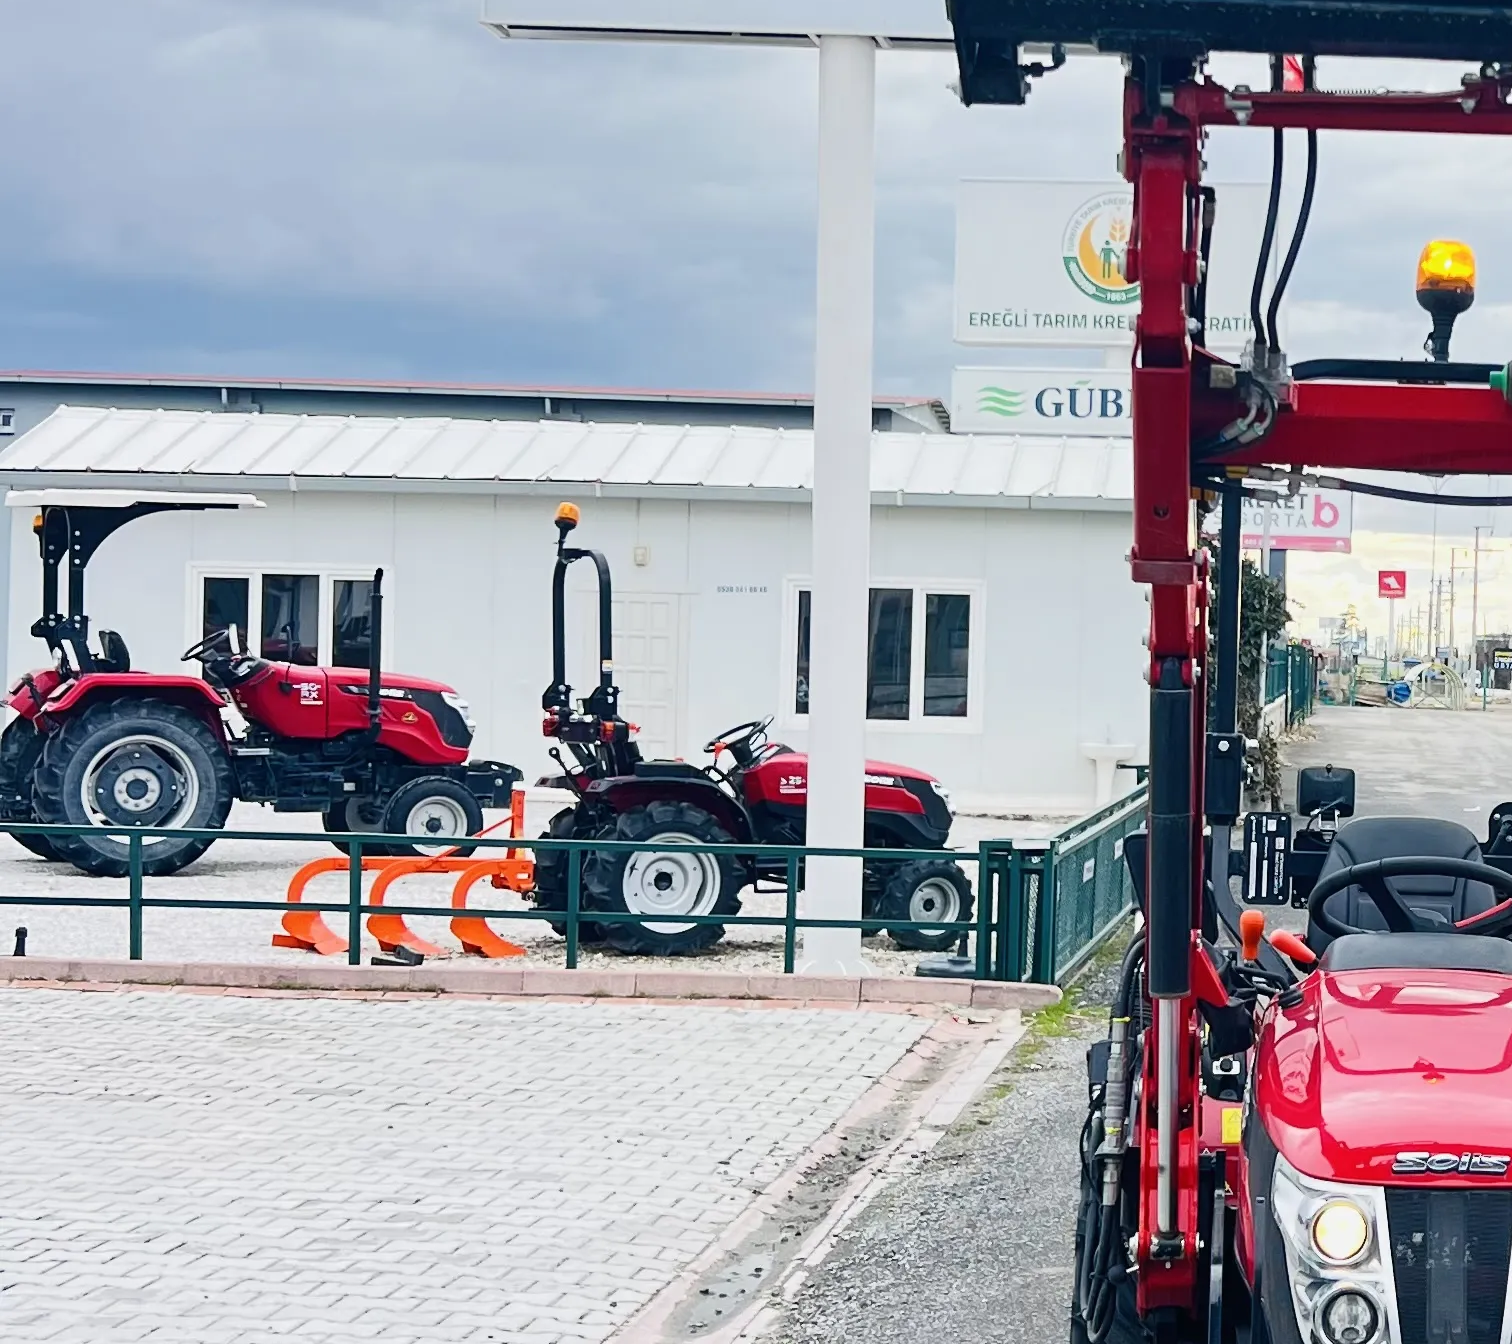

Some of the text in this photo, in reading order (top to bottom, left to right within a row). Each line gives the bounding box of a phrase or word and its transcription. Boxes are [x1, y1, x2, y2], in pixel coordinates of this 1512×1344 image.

[969, 309, 1028, 328] EREĞLİ
[1033, 313, 1087, 330] TARIM
[1094, 314, 1130, 330] KRE
[1035, 379, 1133, 418] GÜB
